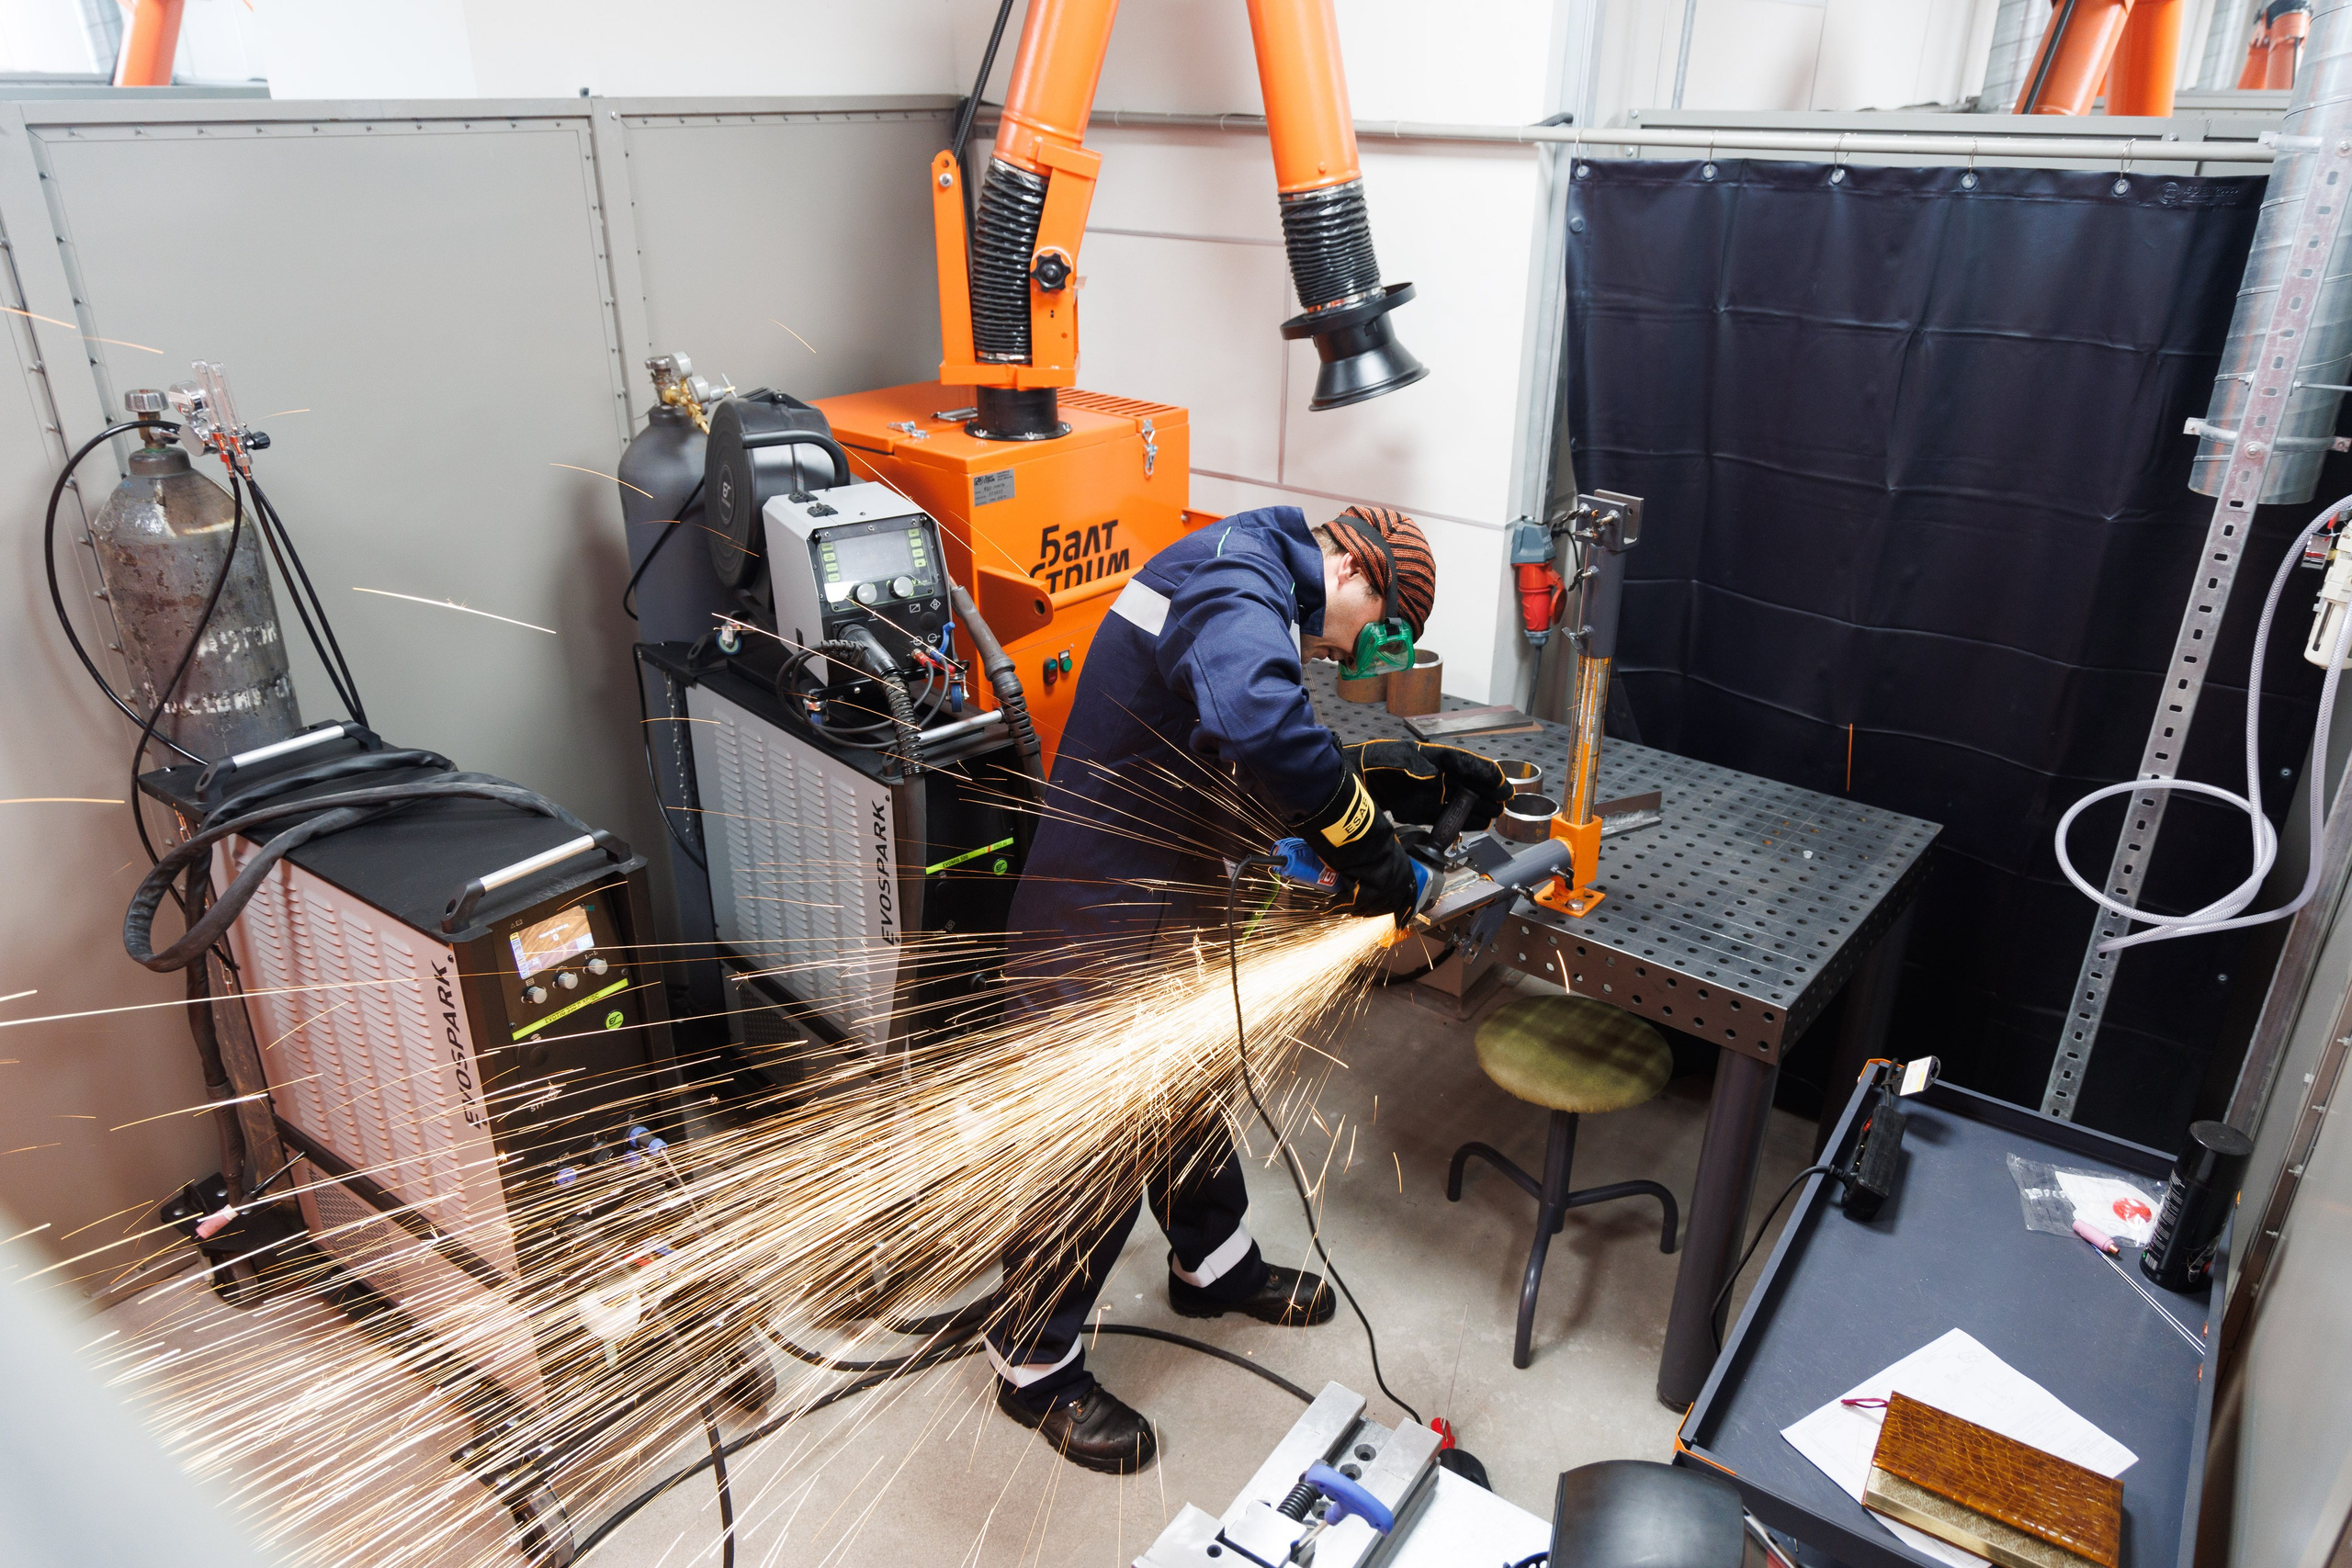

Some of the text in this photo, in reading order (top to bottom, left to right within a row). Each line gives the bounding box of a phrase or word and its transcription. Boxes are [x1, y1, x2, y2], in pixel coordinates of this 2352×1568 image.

[1040, 519, 1119, 568] Балт
[871, 800, 895, 946] EVOSPARK
[430, 959, 481, 1130] EVOSPARK
